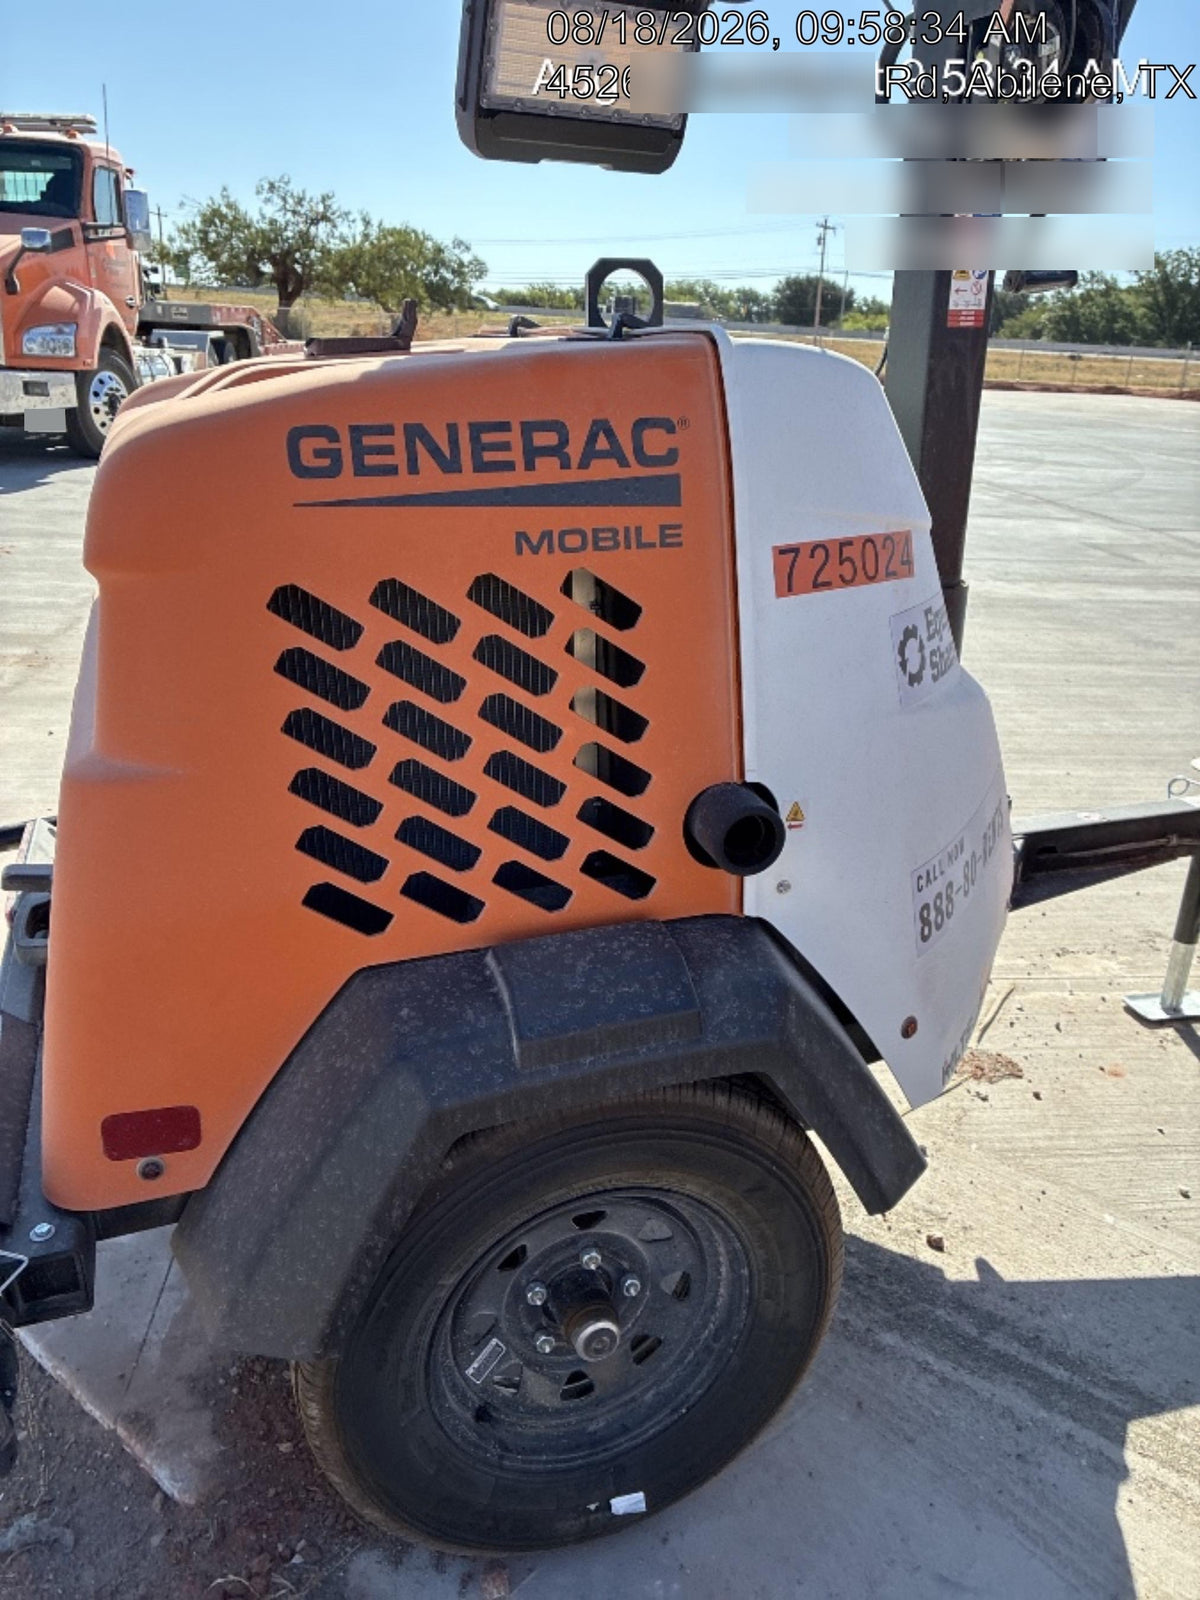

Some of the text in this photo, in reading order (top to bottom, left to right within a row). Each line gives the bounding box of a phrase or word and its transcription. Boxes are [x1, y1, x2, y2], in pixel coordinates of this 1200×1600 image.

[286, 417, 680, 480] GENERAC
[515, 523, 683, 556] MOBILE
[778, 535, 913, 594] 725024
[916, 858, 946, 894] CALL
